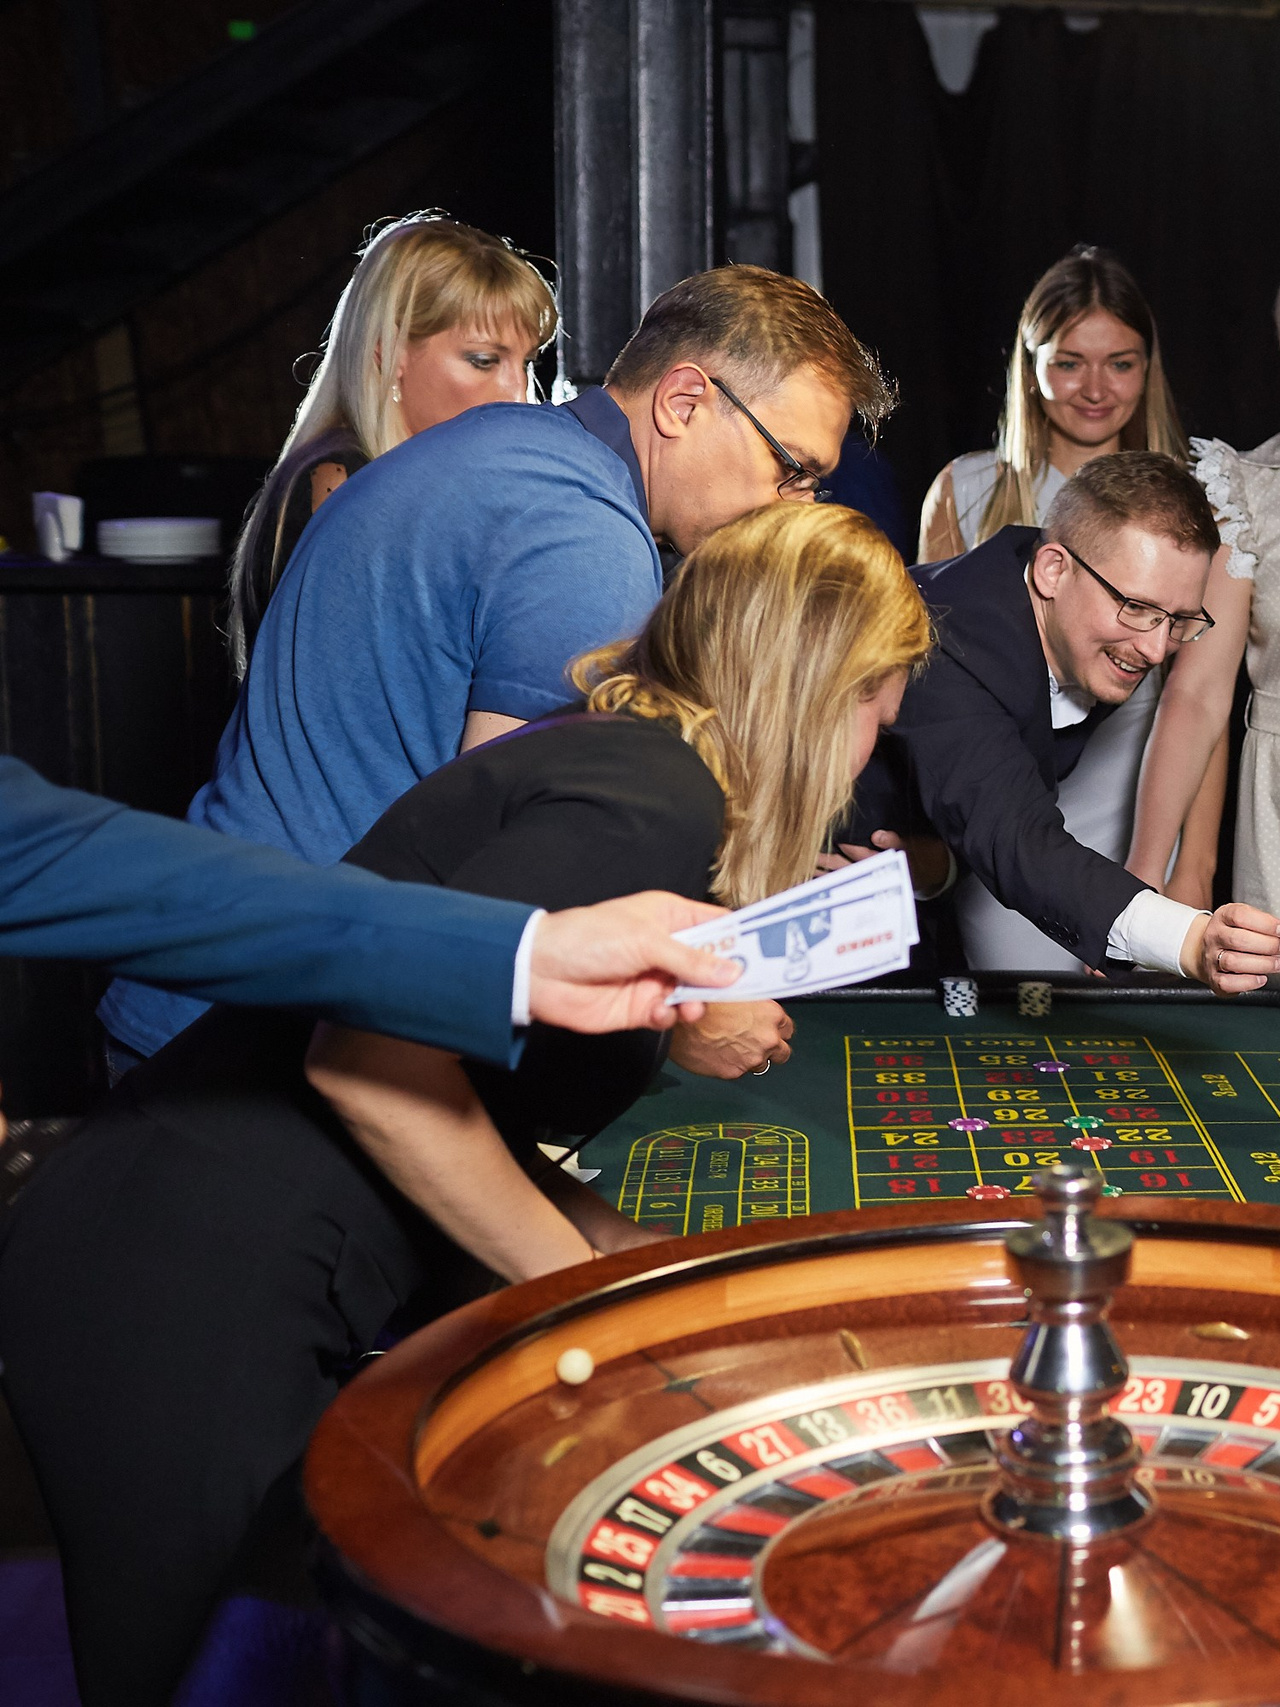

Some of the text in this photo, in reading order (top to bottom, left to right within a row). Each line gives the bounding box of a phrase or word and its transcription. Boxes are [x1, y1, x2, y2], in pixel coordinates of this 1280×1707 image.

[874, 1055, 924, 1066] 36
[978, 1054, 1028, 1065] 35
[1083, 1054, 1131, 1065] 34
[875, 1072, 926, 1083] 33
[1092, 1071, 1140, 1082] 31
[876, 1090, 929, 1103] 30
[987, 1089, 1040, 1101] 29
[1094, 1088, 1150, 1100] 28
[880, 1110, 934, 1123] 27
[993, 1108, 1049, 1121] 26
[1105, 1107, 1160, 1120] 25
[881, 1132, 939, 1146] 24
[1001, 1130, 1057, 1144] 23
[1115, 1128, 1172, 1141] 22
[888, 1154, 939, 1169] 21
[1003, 1151, 1062, 1166] 20
[1129, 1150, 1181, 1164] 19
[887, 1178, 941, 1194] 18
[1014, 1176, 1036, 1191] 7
[1139, 1172, 1193, 1188] 16
[927, 1385, 965, 1420] 11
[1118, 1378, 1167, 1413] 23
[1187, 1383, 1231, 1419] 10
[856, 1395, 909, 1430] 36
[798, 1409, 848, 1446] 13
[739, 1425, 793, 1465] 27
[696, 1450, 743, 1482] 6
[645, 1470, 709, 1510] 34
[615, 1497, 673, 1534] 17
[583, 1562, 643, 1590] 2
